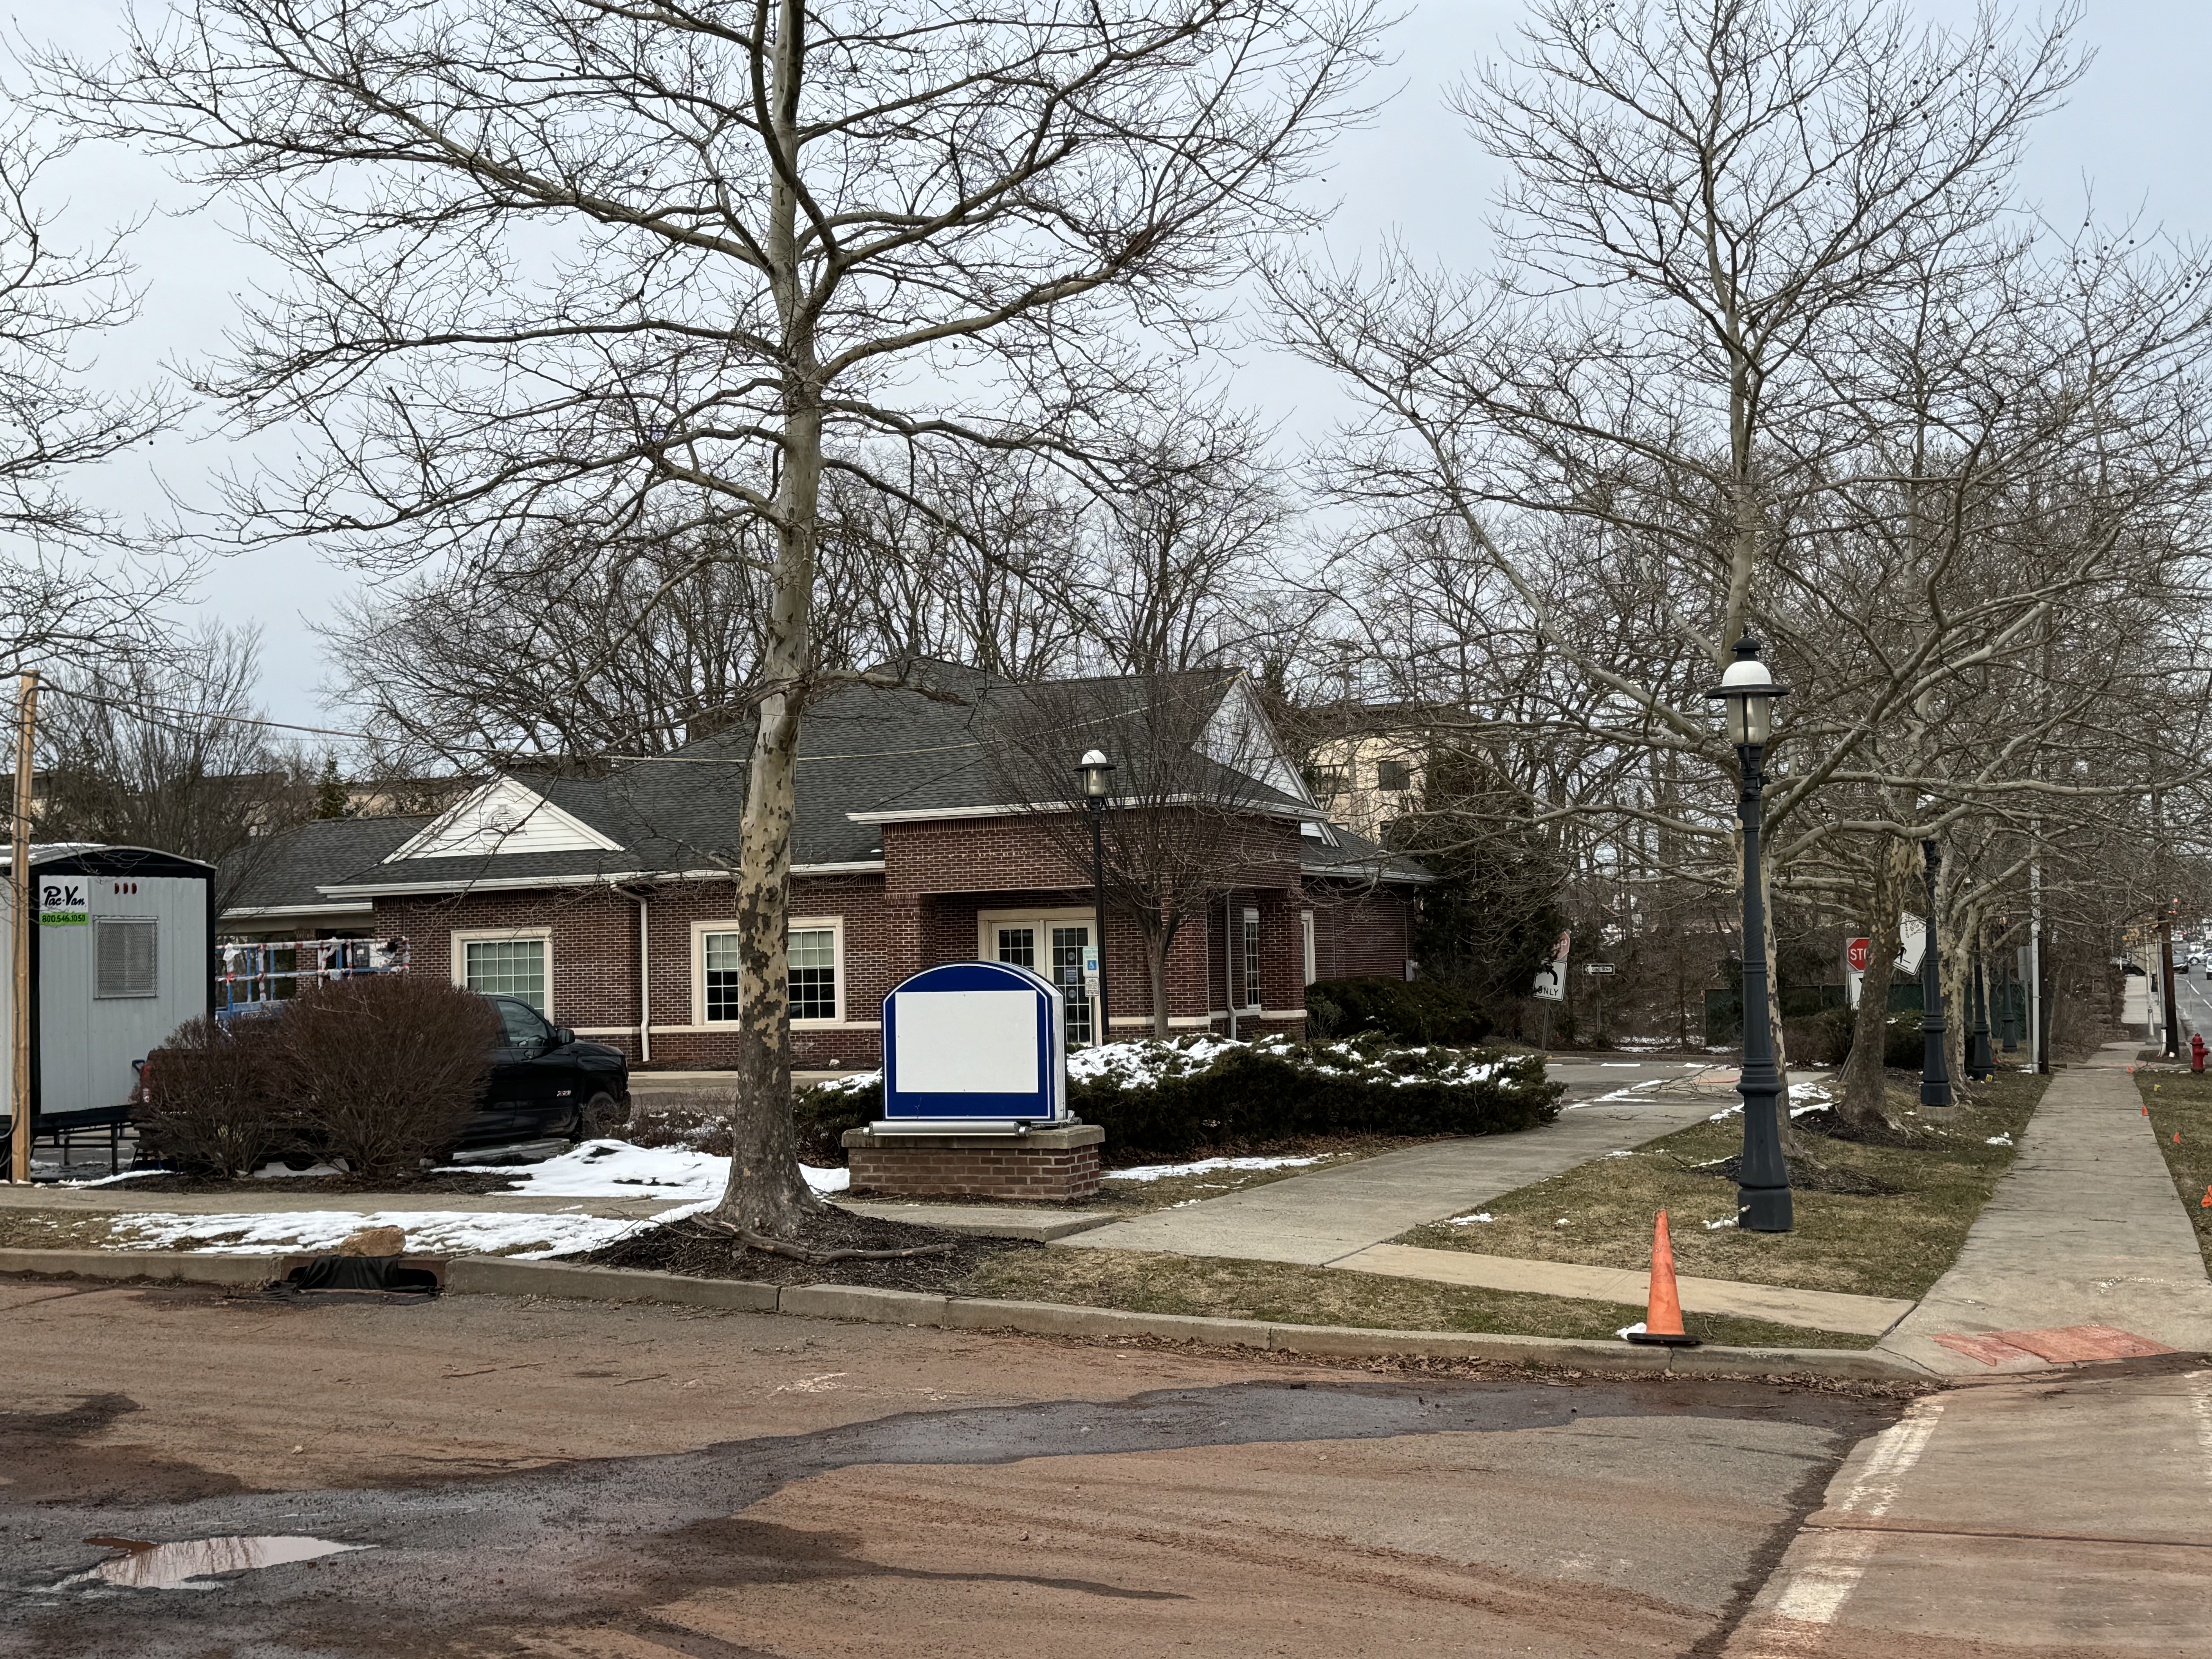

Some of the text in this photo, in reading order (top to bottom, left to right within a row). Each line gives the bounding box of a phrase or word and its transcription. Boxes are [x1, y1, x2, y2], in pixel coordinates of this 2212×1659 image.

[43, 886, 85, 907] Pac-Van
[1850, 948, 1867, 960] ST
[1538, 986, 1559, 996] ONLY
